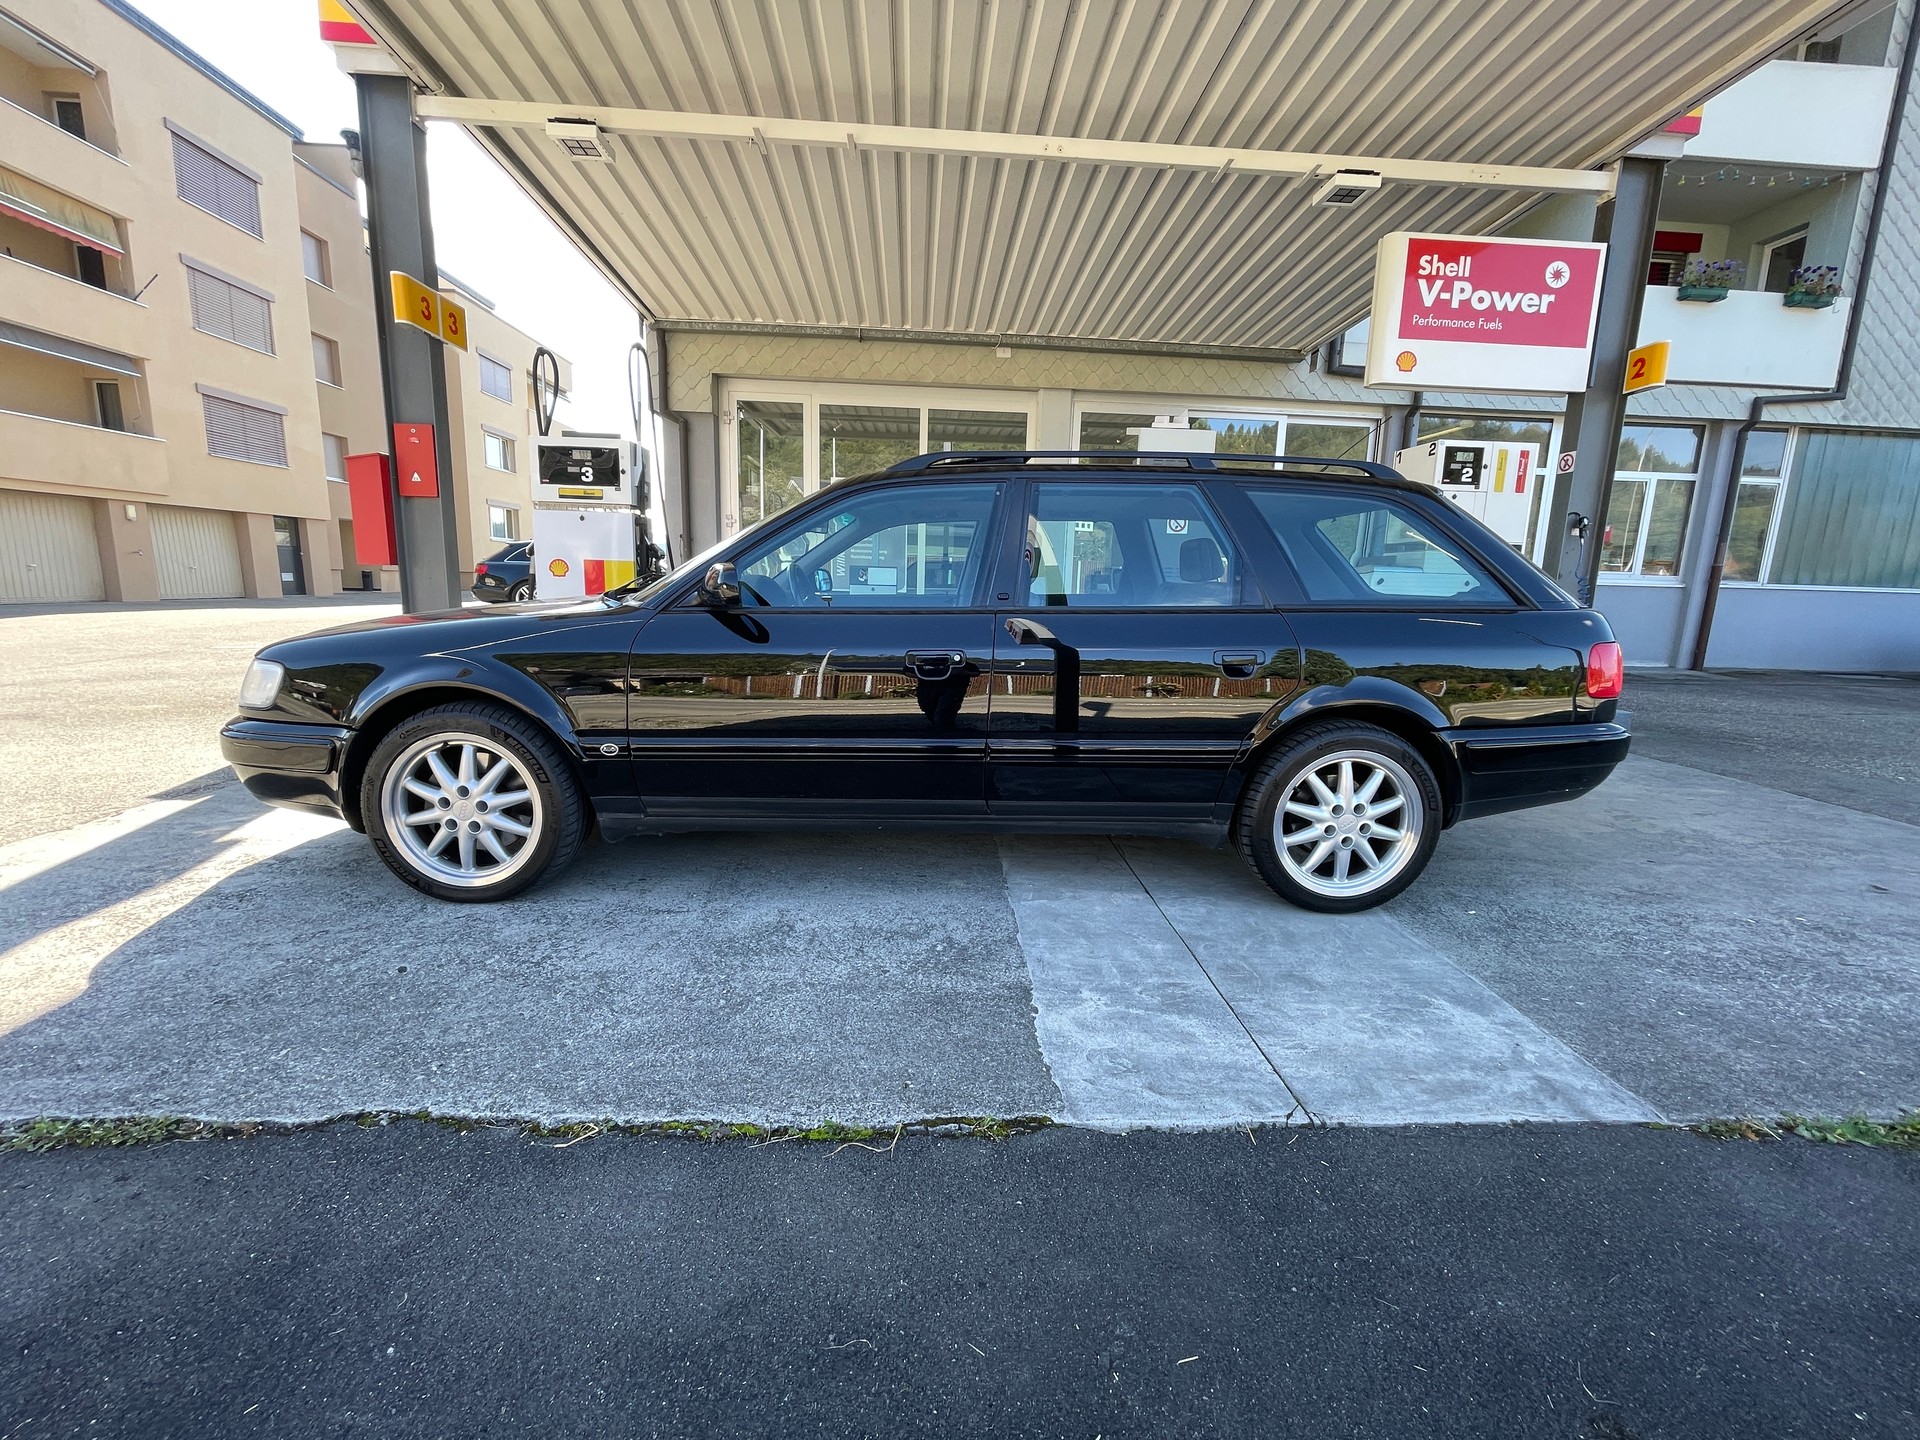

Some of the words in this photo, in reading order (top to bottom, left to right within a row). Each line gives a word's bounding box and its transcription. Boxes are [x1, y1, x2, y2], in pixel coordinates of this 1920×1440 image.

[1418, 254, 1472, 278] Shell
[1417, 278, 1555, 314] V-Power
[420, 296, 432, 321] 3
[448, 311, 459, 336] 3
[1412, 313, 1476, 329] Performance
[1478, 317, 1503, 331] Fuels
[1631, 357, 1647, 380] 2
[1396, 451, 1402, 464] 1
[1428, 442, 1437, 456] 2
[580, 466, 594, 483] 3
[1461, 467, 1474, 483] 2
